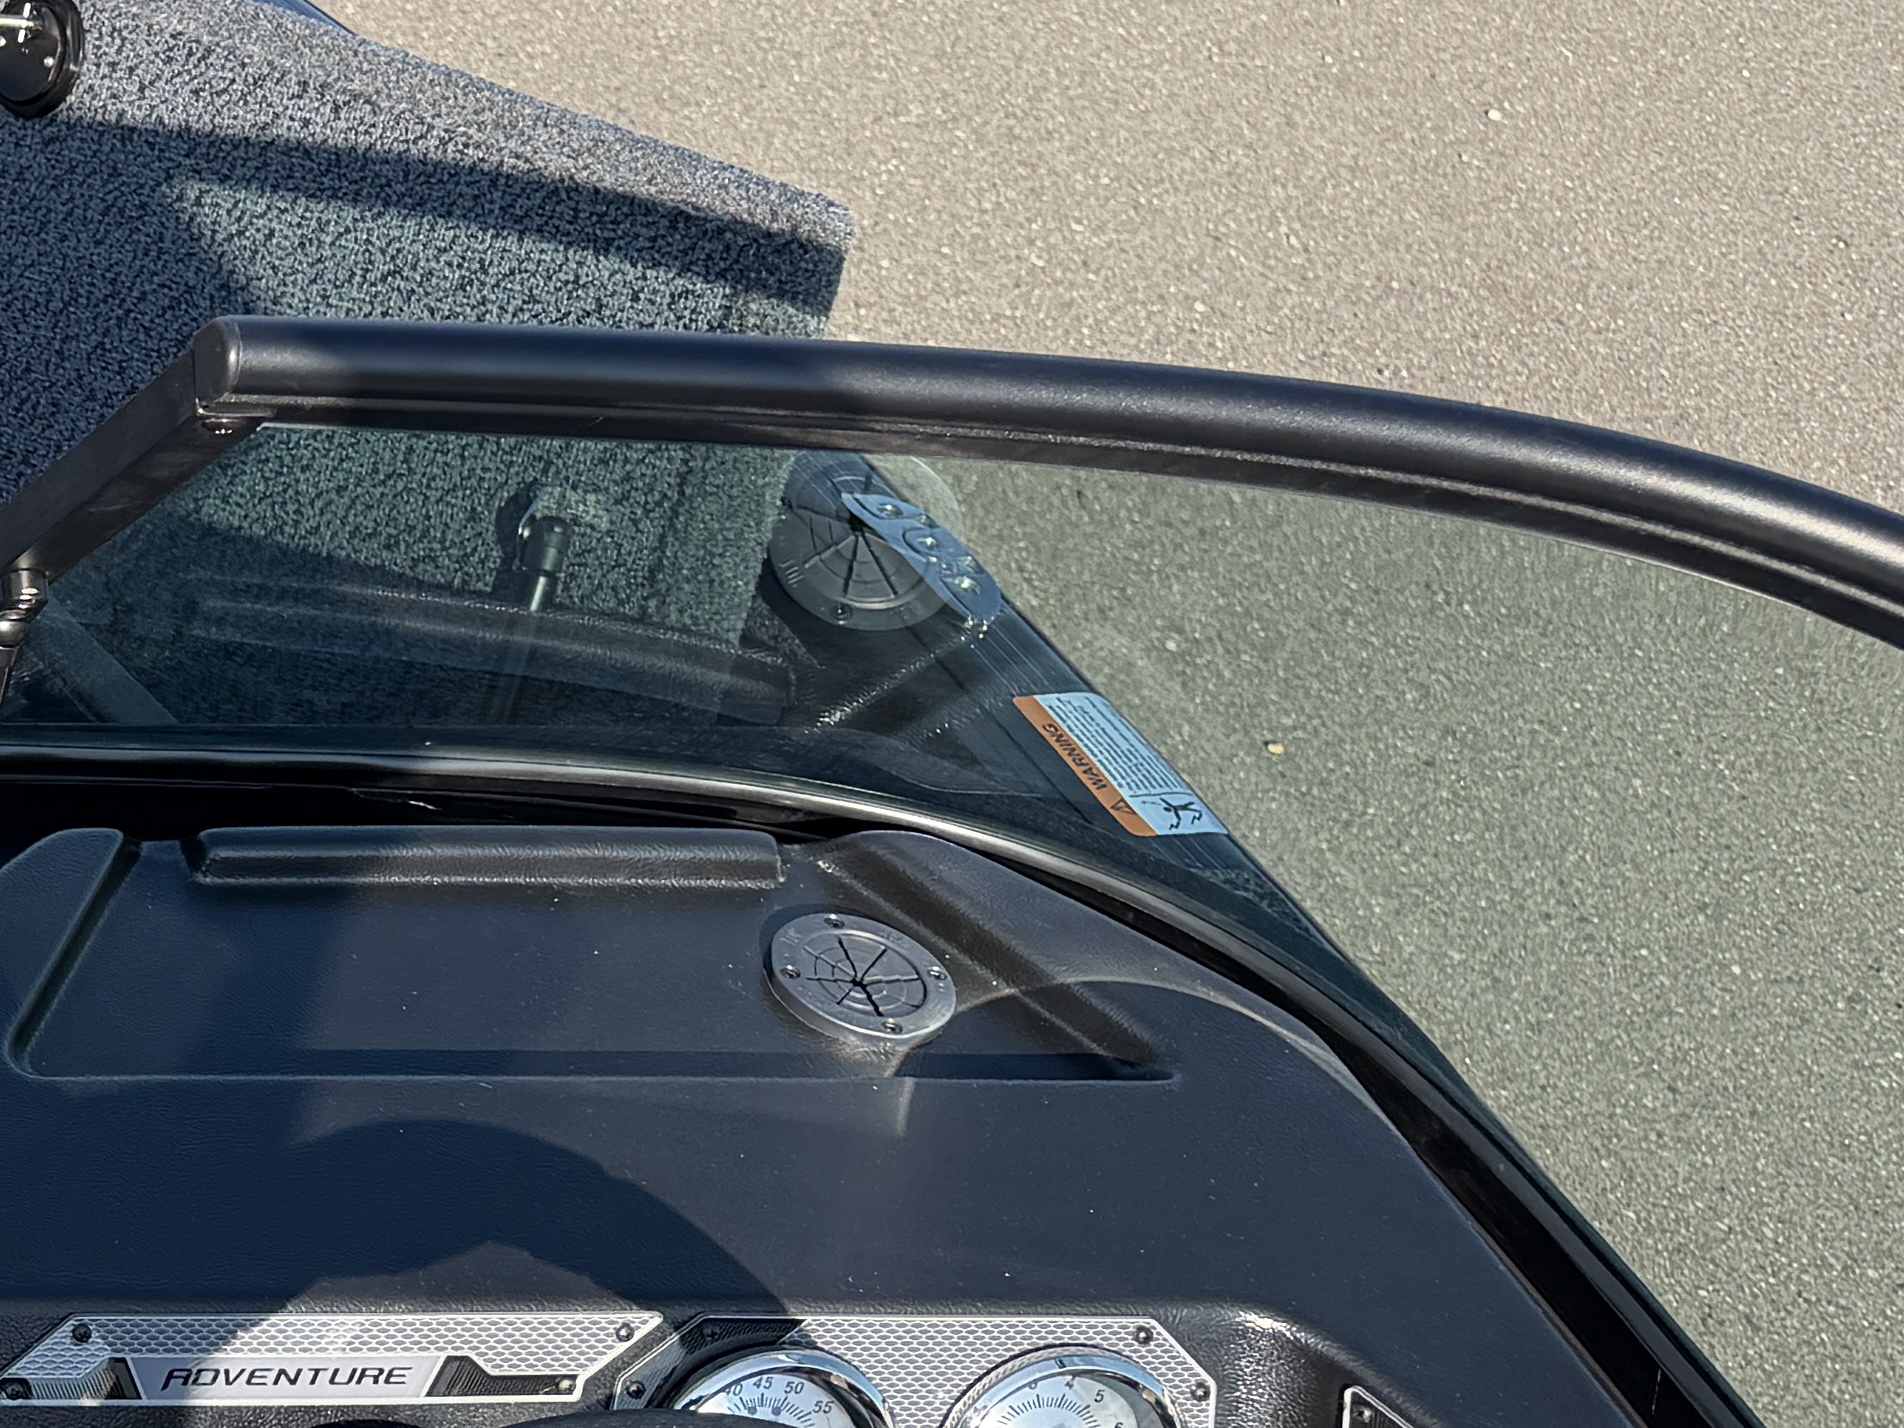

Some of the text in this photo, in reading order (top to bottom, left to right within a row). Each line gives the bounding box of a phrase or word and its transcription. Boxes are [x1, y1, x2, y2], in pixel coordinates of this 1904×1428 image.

[1041, 723, 1108, 791] WARNING
[160, 1366, 414, 1392] ADVENTURE
[752, 1376, 774, 1390] 45
[784, 1381, 805, 1394] 50
[1094, 1389, 1105, 1403] 5
[813, 1400, 834, 1414] 55
